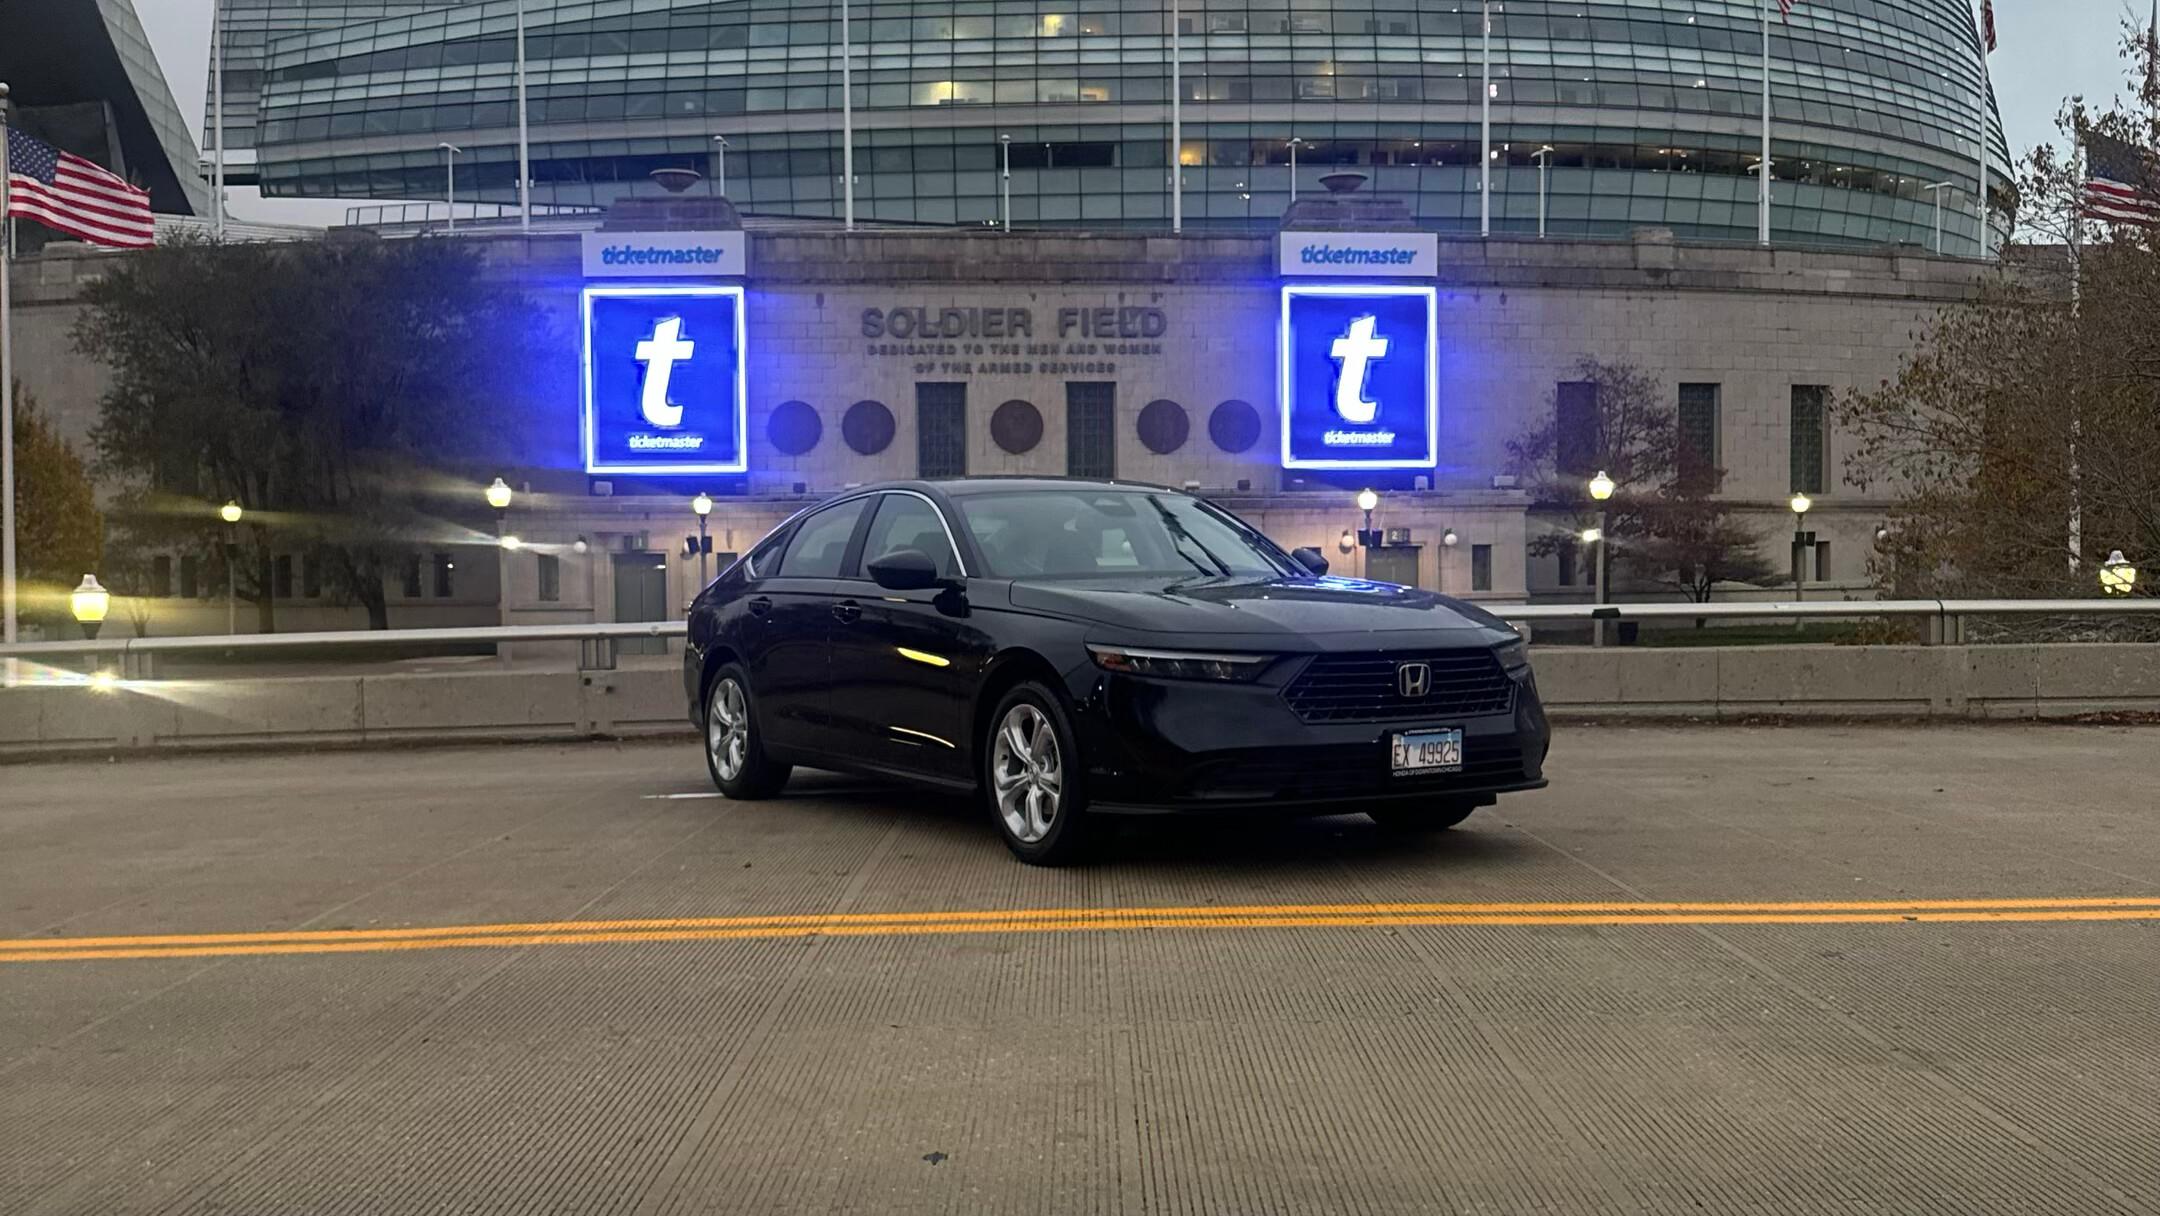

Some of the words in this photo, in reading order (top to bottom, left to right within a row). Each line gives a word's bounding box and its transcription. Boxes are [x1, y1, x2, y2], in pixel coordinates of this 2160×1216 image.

[602, 245, 723, 265] ticketmaster
[1301, 244, 1417, 265] ticketmaster
[861, 307, 1033, 339] SOLDIER
[1058, 307, 1167, 339] FIELD
[867, 343, 956, 356] DEDICATED
[963, 343, 983, 356] TO
[990, 343, 1019, 356] THE
[1027, 343, 1059, 356] MEN
[1067, 343, 1097, 356] AND
[1103, 343, 1162, 356] WOMEN
[634, 315, 695, 427] t
[915, 362, 935, 375] OF
[941, 362, 972, 375] THE
[978, 362, 1032, 375] ARMED
[1039, 362, 1116, 375] SERVICES
[1331, 314, 1389, 423] t
[629, 435, 703, 449] ticketmaster
[1323, 430, 1395, 445] ticketmaster
[1394, 743, 1410, 767] EX
[1419, 741, 1459, 764] 49925
